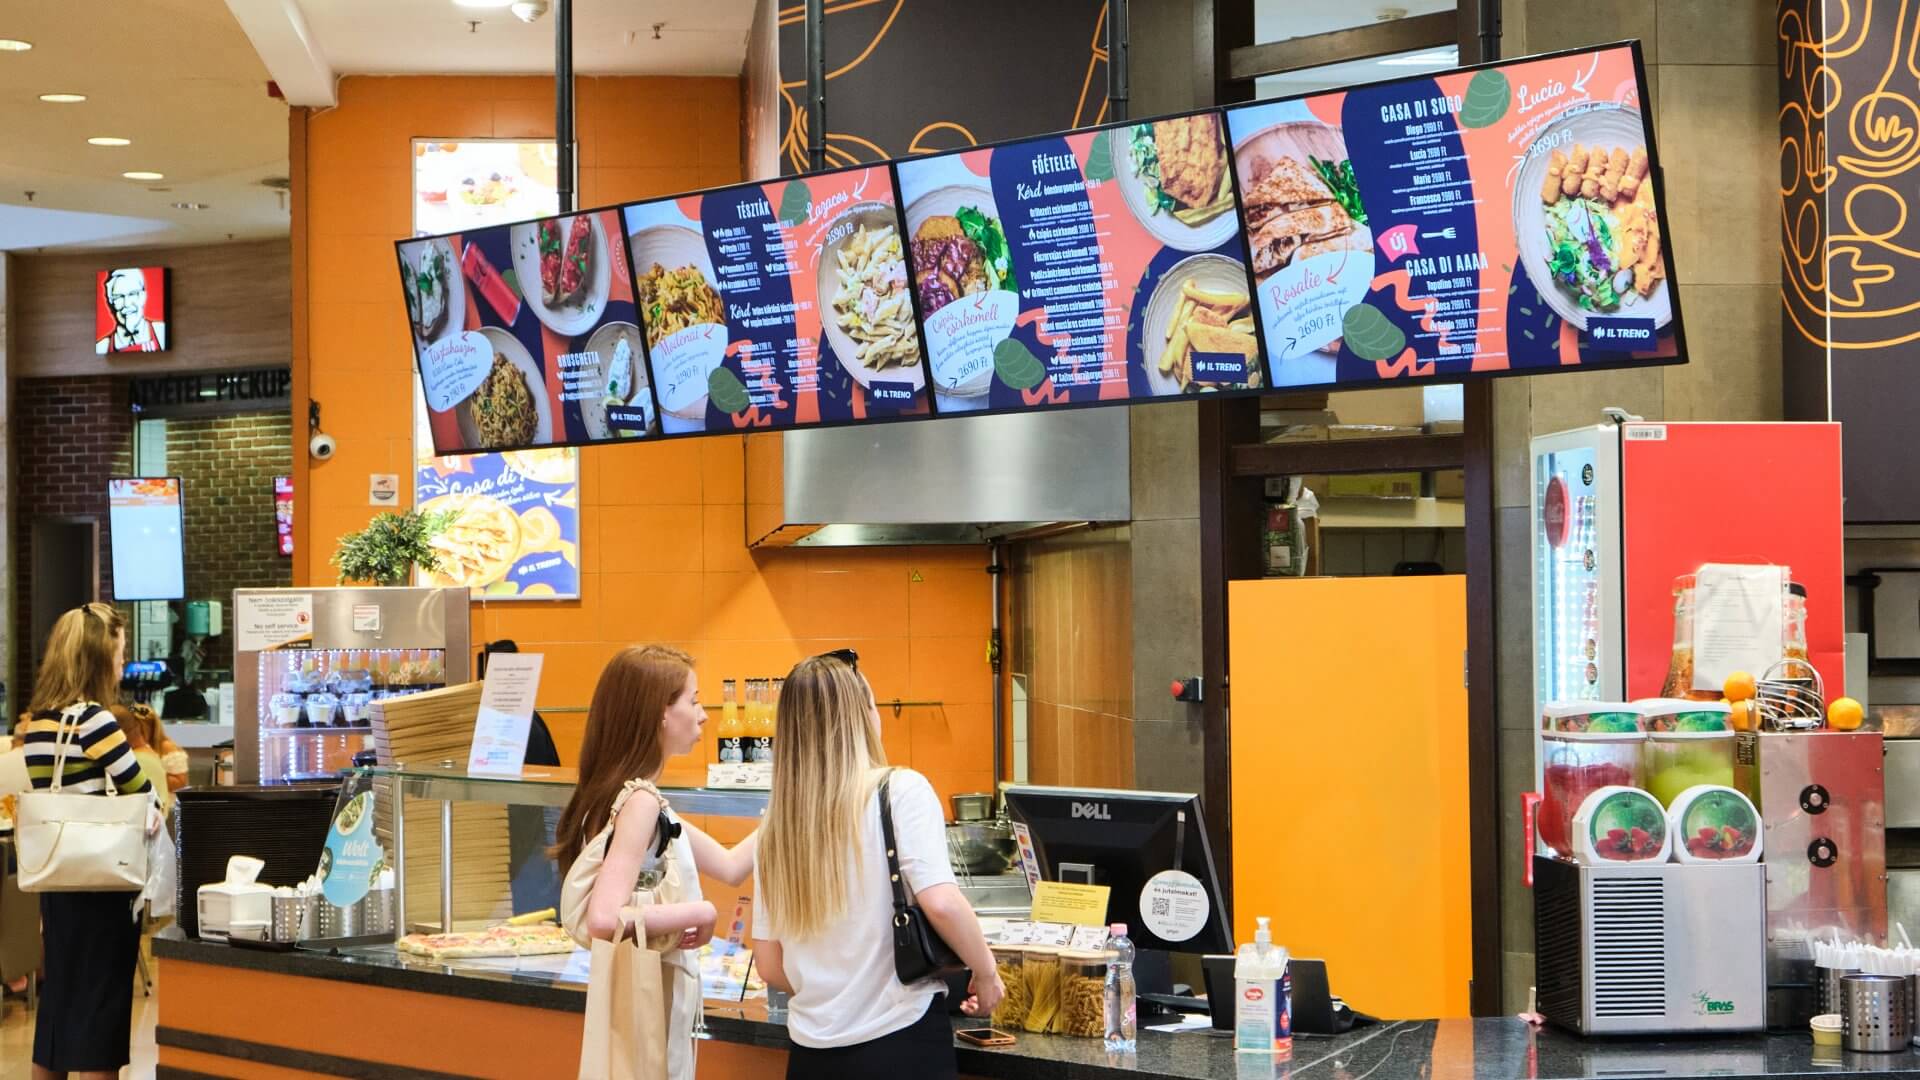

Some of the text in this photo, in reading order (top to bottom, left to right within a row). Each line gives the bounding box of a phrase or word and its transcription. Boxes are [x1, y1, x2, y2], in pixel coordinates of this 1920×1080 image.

[1516, 79, 1566, 114] Lucia
[1380, 95, 1462, 123] CASA DI SUGO
[1405, 124, 1424, 136] Diego
[1032, 153, 1077, 175] FŐÉTELEK
[1410, 148, 1427, 161] Lucia
[1413, 174, 1431, 186] Mario
[1016, 180, 1042, 201] Kérd
[1410, 193, 1441, 206] Francesco
[736, 197, 771, 220] TÉSZTÁK
[1405, 258, 1437, 277] CASA
[1438, 255, 1453, 274] DI
[1270, 267, 1320, 311] Rosalie
[946, 303, 998, 337] csirkemell
[1298, 316, 1323, 339] 2690
[1607, 328, 1650, 339] IL TRENO
[958, 359, 978, 379] 2690
[1207, 362, 1242, 372] IL TRENO
[883, 390, 911, 399] IL TRENO
[1071, 801, 1111, 820] DELL
[1707, 1000, 1734, 1012] BRAS
